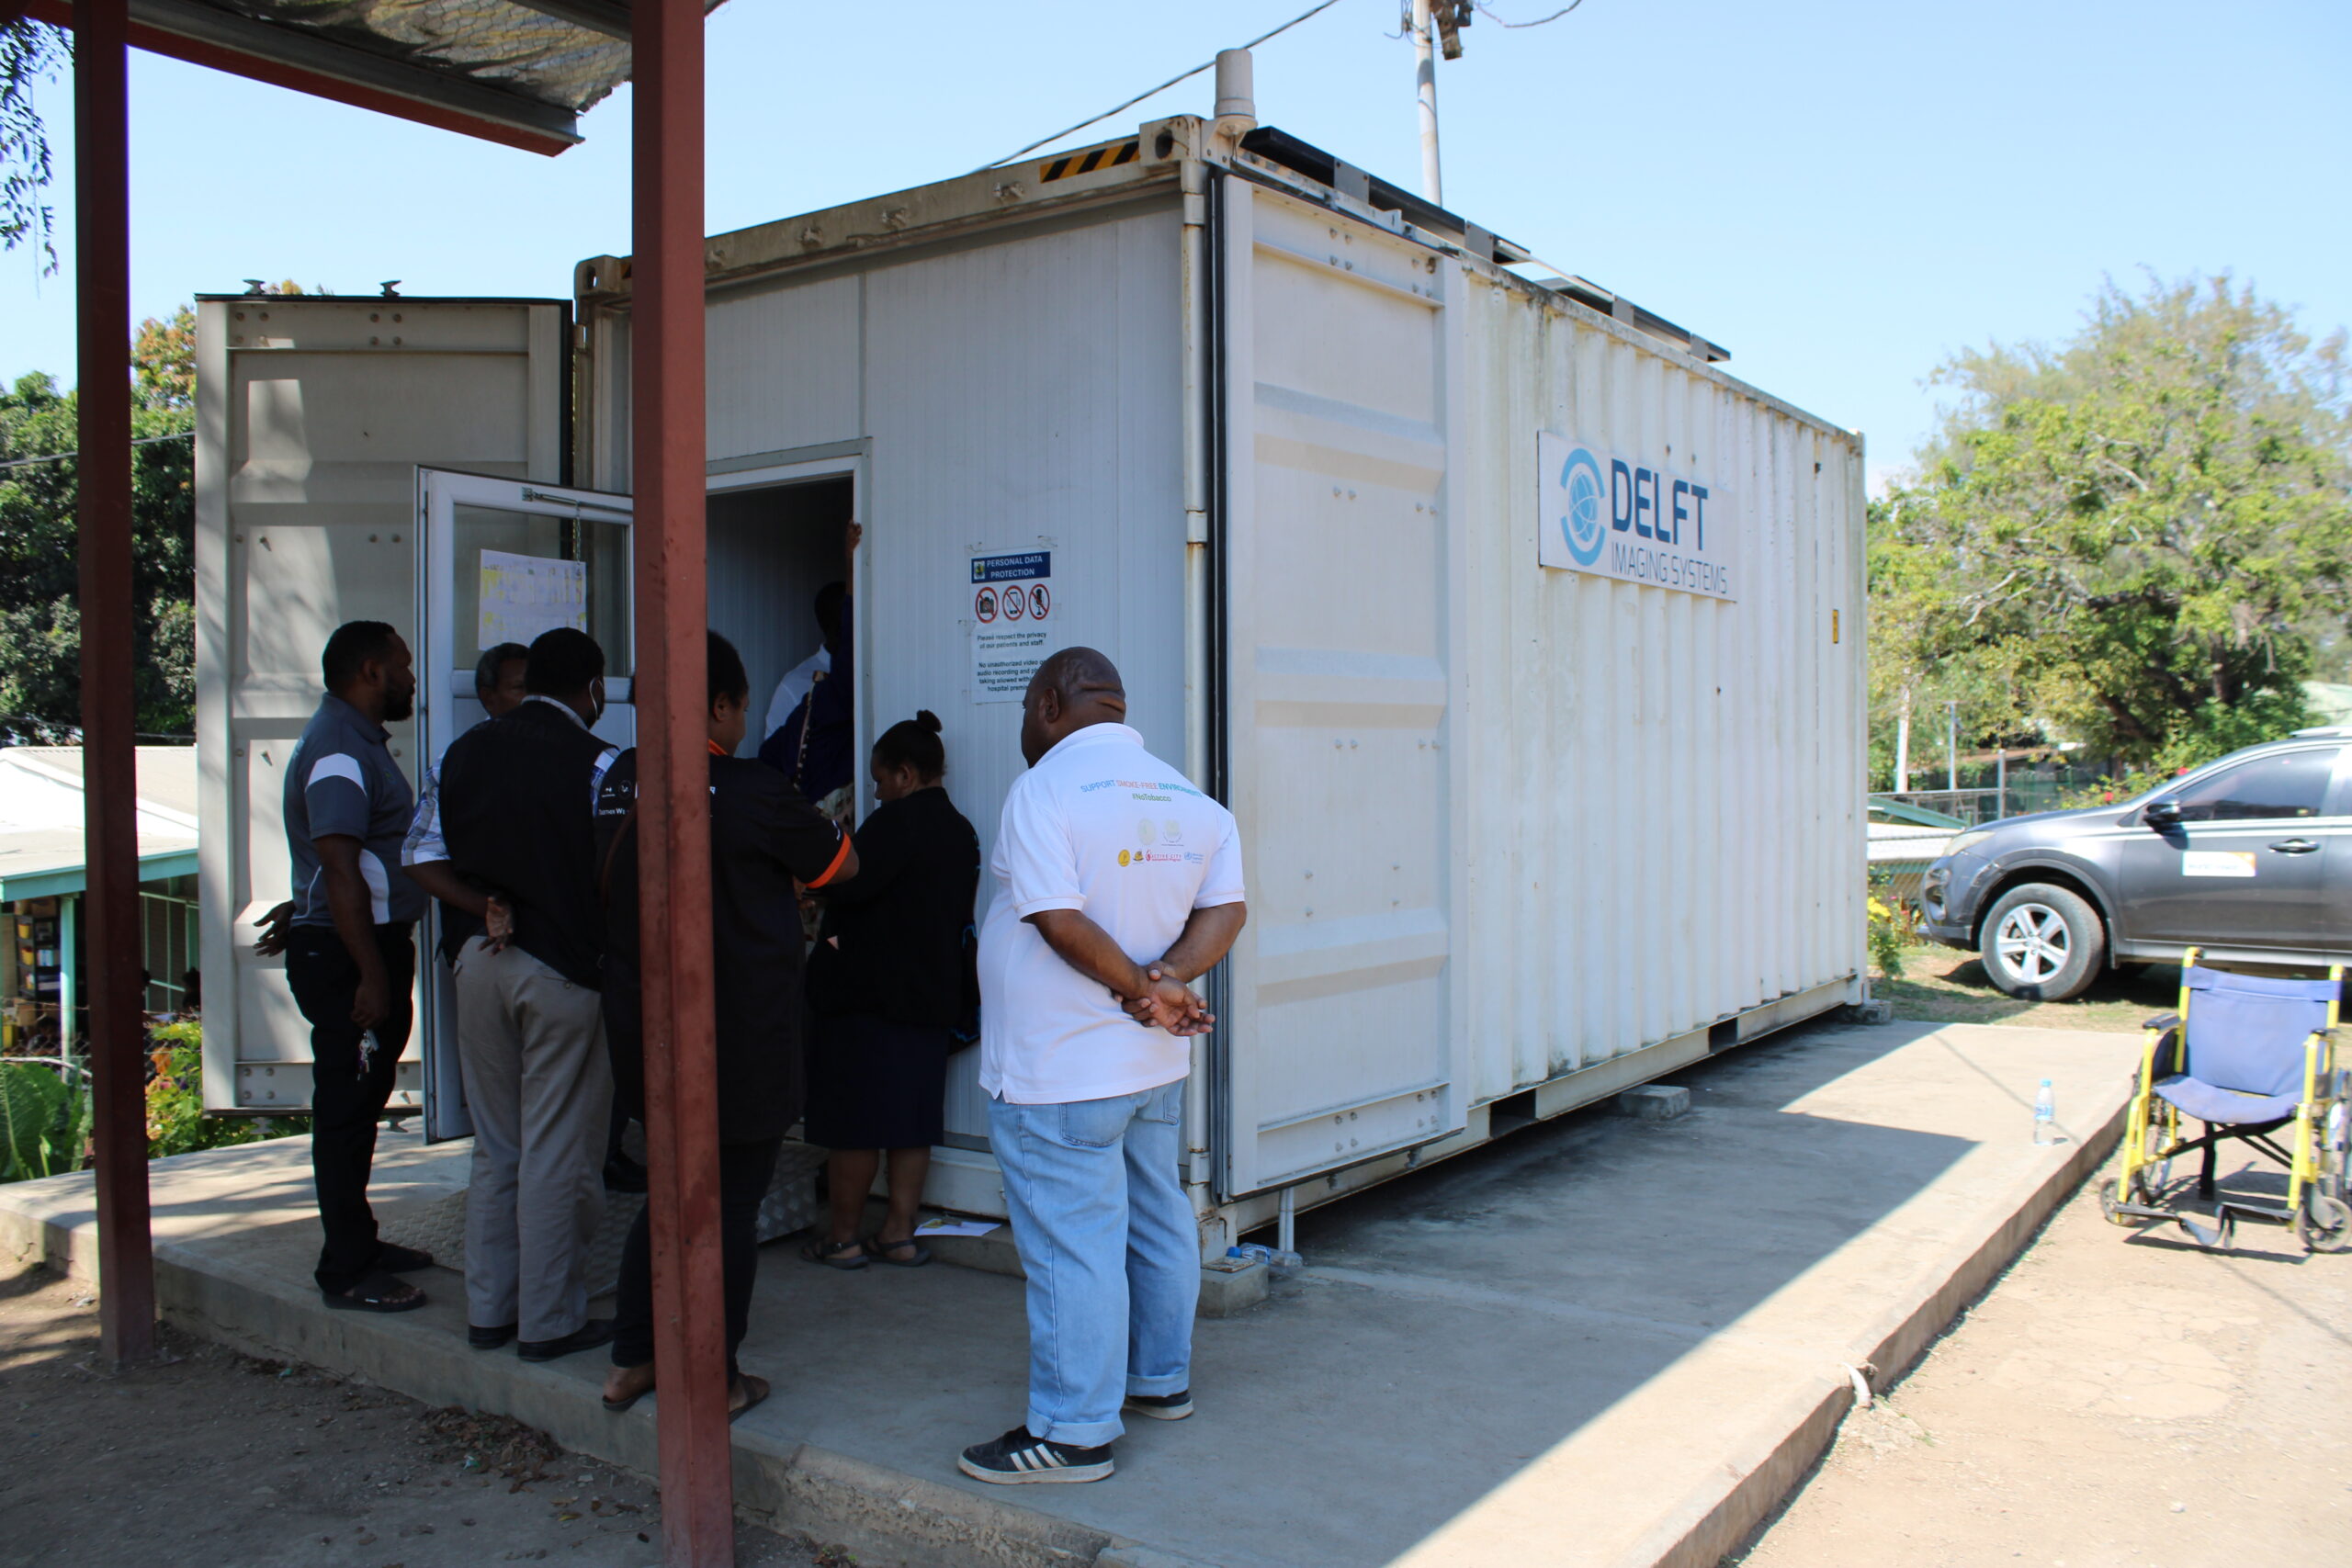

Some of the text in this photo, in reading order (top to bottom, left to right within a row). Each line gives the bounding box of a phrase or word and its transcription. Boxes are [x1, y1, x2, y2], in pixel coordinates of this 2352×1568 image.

[1611, 457, 1709, 551] DELFT
[986, 555, 1043, 567] PERSONAL DATA
[1611, 541, 1728, 595] IMAGING SYSTEMS
[990, 569, 1035, 579] PROTECTION
[995, 633, 1016, 641] respect
[1026, 631, 1047, 640] privacy
[996, 641, 1018, 649] patients
[987, 660, 1023, 668] unauthorized
[992, 669, 1019, 677] recording
[987, 684, 1009, 693] hospital
[1080, 780, 1116, 793] SUPPORT
[1115, 780, 1159, 790] SMOKE-FREE
[1132, 792, 1172, 802] #NoTobacco
